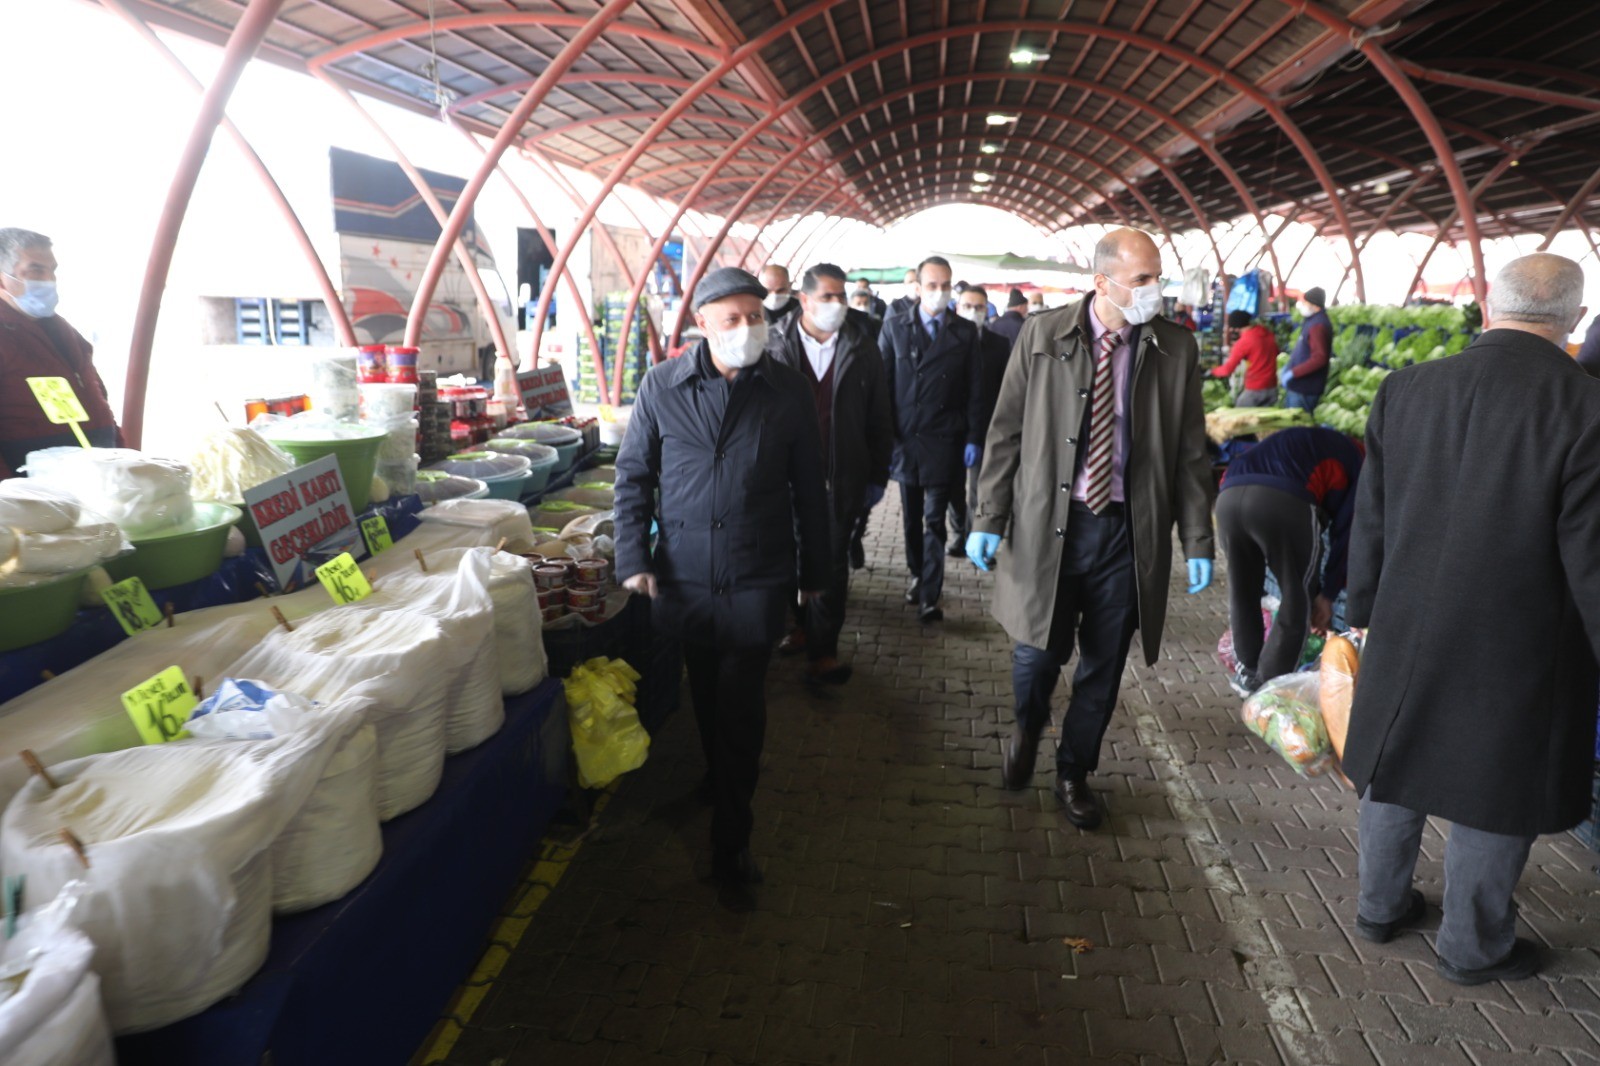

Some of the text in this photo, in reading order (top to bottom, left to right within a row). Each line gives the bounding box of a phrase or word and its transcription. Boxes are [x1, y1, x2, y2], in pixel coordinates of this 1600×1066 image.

[251, 469, 342, 530] KREDİ KARTI
[269, 501, 351, 565] GEÇERLİDİR
